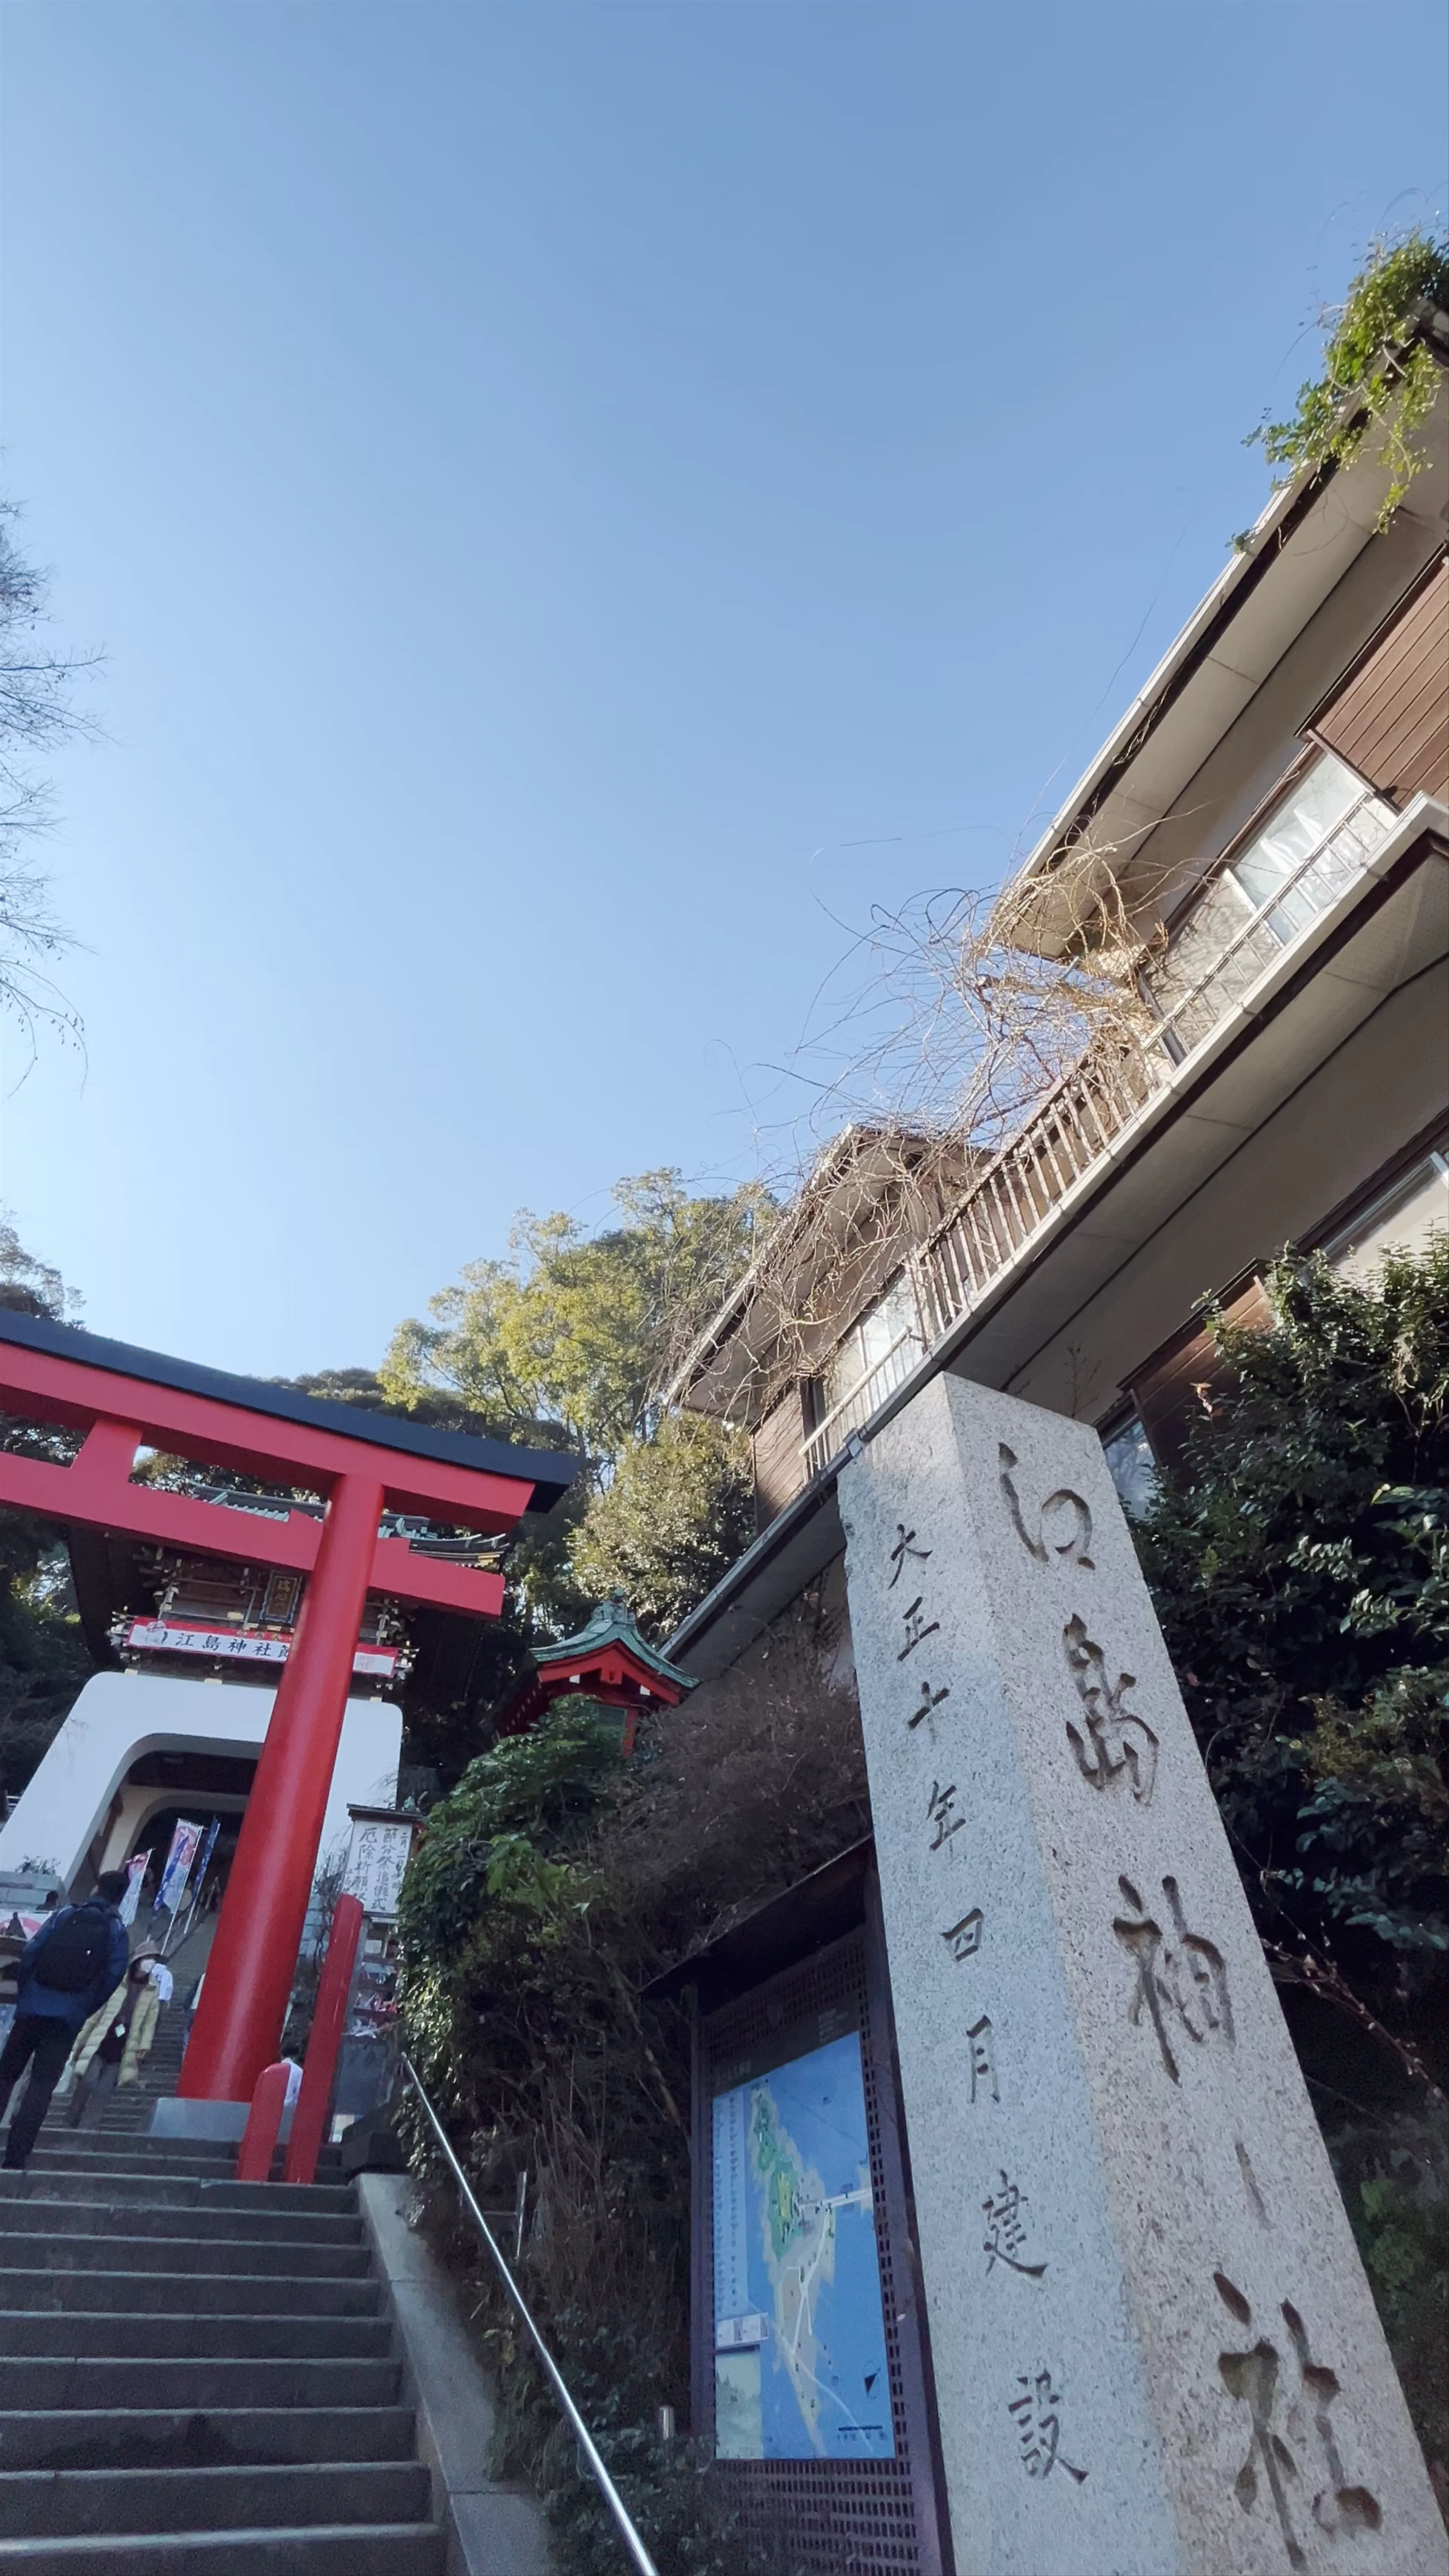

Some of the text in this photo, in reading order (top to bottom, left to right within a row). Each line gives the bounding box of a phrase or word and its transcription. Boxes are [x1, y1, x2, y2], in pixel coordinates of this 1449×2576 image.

[145, 1631, 290, 1658] 江島神社
[888, 1523, 1089, 2484] 大正十年四月建設
[998, 1442, 1382, 2570] 江島神社
